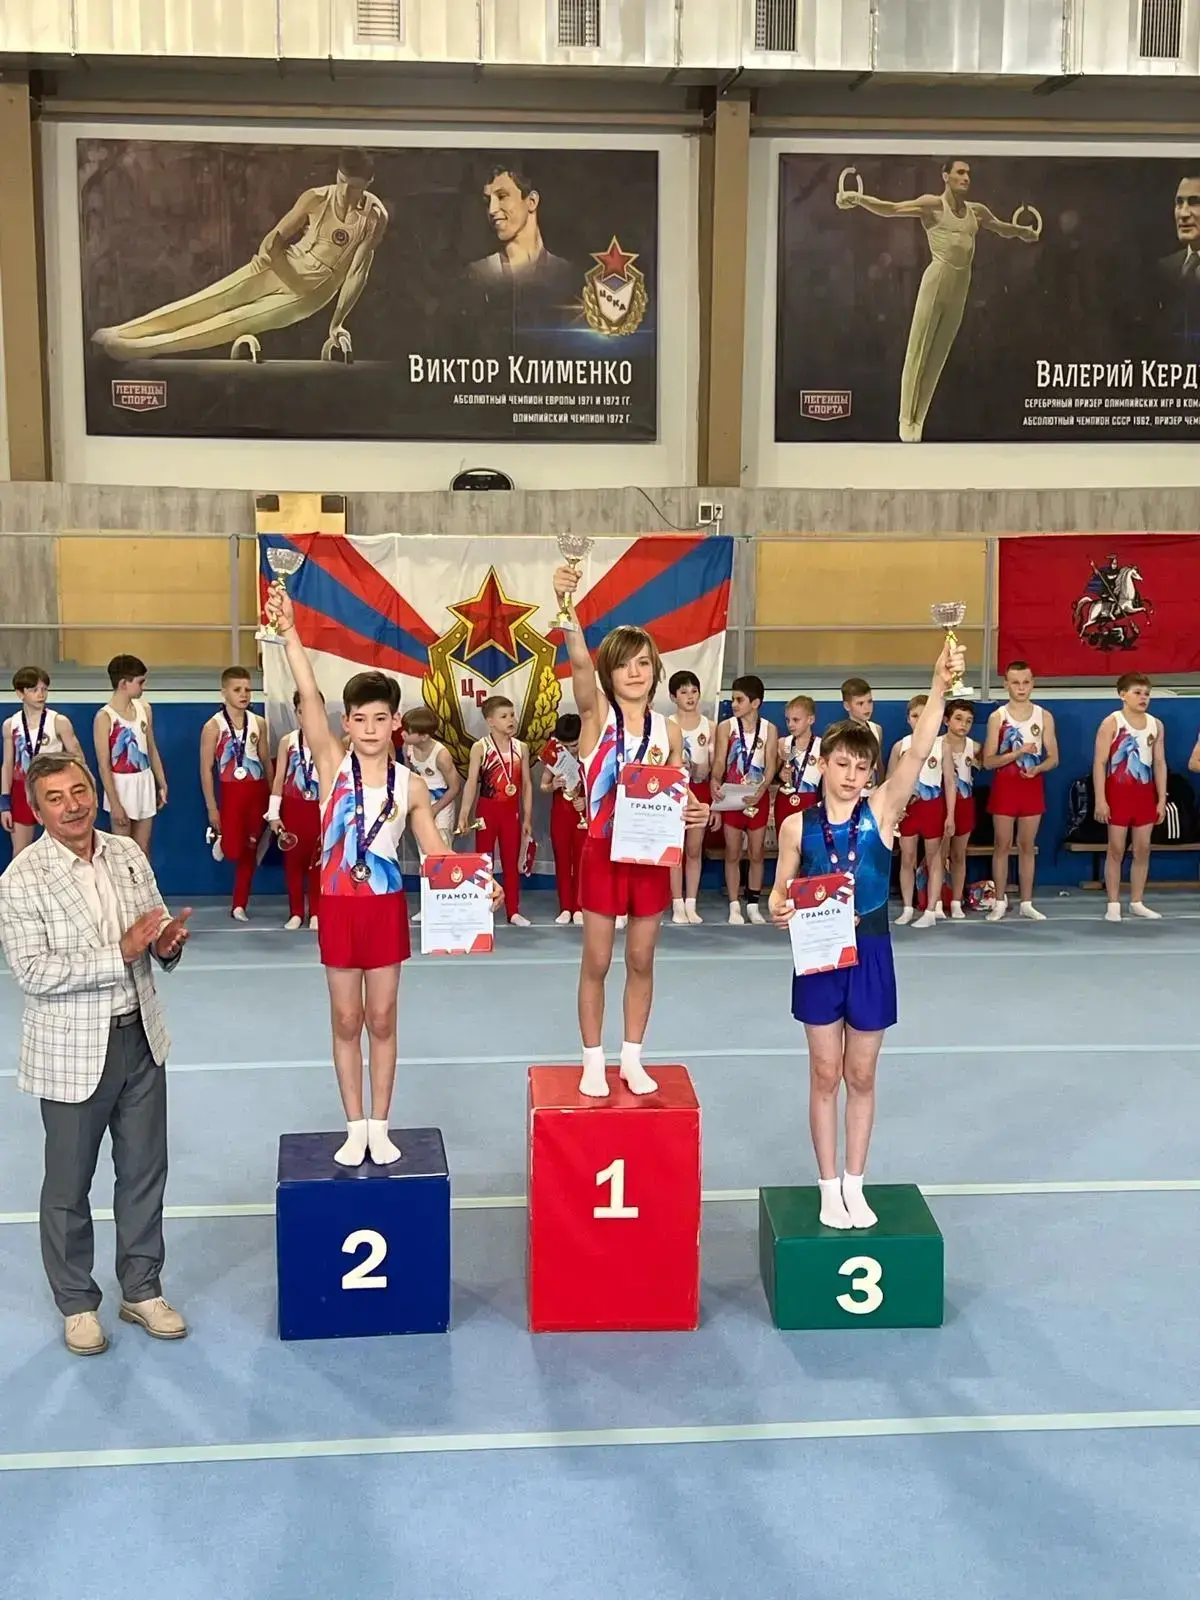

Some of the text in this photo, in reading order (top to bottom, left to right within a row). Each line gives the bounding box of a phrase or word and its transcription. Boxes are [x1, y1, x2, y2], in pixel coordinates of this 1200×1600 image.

[408, 354, 633, 385] ВИКТОР КЛИМЕНКО
[1036, 359, 1200, 390] ВАЛЕРИЙ КЕРД
[116, 384, 164, 395] ЛЕГЕНДЫ
[121, 395, 159, 405] СПОРТА
[453, 394, 507, 405] АБСОЛЮТНЫЙ
[508, 395, 544, 405] ЧЕМПИОН
[545, 395, 576, 406] ЕВРОПЫ
[578, 395, 593, 406] 1971
[595, 396, 601, 406] И
[621, 396, 633, 406] ГГ.
[803, 395, 849, 405] ЛЕГЕНДЫ
[1024, 397, 1200, 408] СЕРЕБРЯНЫЙ ПРИЗЕР ОЛИМПИЙСКИХ ИГР В КОМ
[808, 405, 844, 415] СПОРТА
[512, 412, 569, 424] ОЛИМПИЙСКИЙ
[570, 413, 605, 424] ЧЕМПИОН
[606, 413, 624, 424] 1972
[1022, 415, 1075, 426] АБСОЛЮТНЫЙ
[1076, 416, 1110, 426] ЧЕМПИОН
[1111, 416, 1131, 426] СССР
[1154, 416, 1183, 426] ПРИЗЕР
[630, 801, 673, 812] ГРАМОТА
[436, 892, 480, 901] ГРАМОТА
[800, 907, 842, 920] ГРАМОТА
[594, 1159, 639, 1219] 1
[341, 1229, 388, 1290] 2
[836, 1256, 884, 1314] 3
